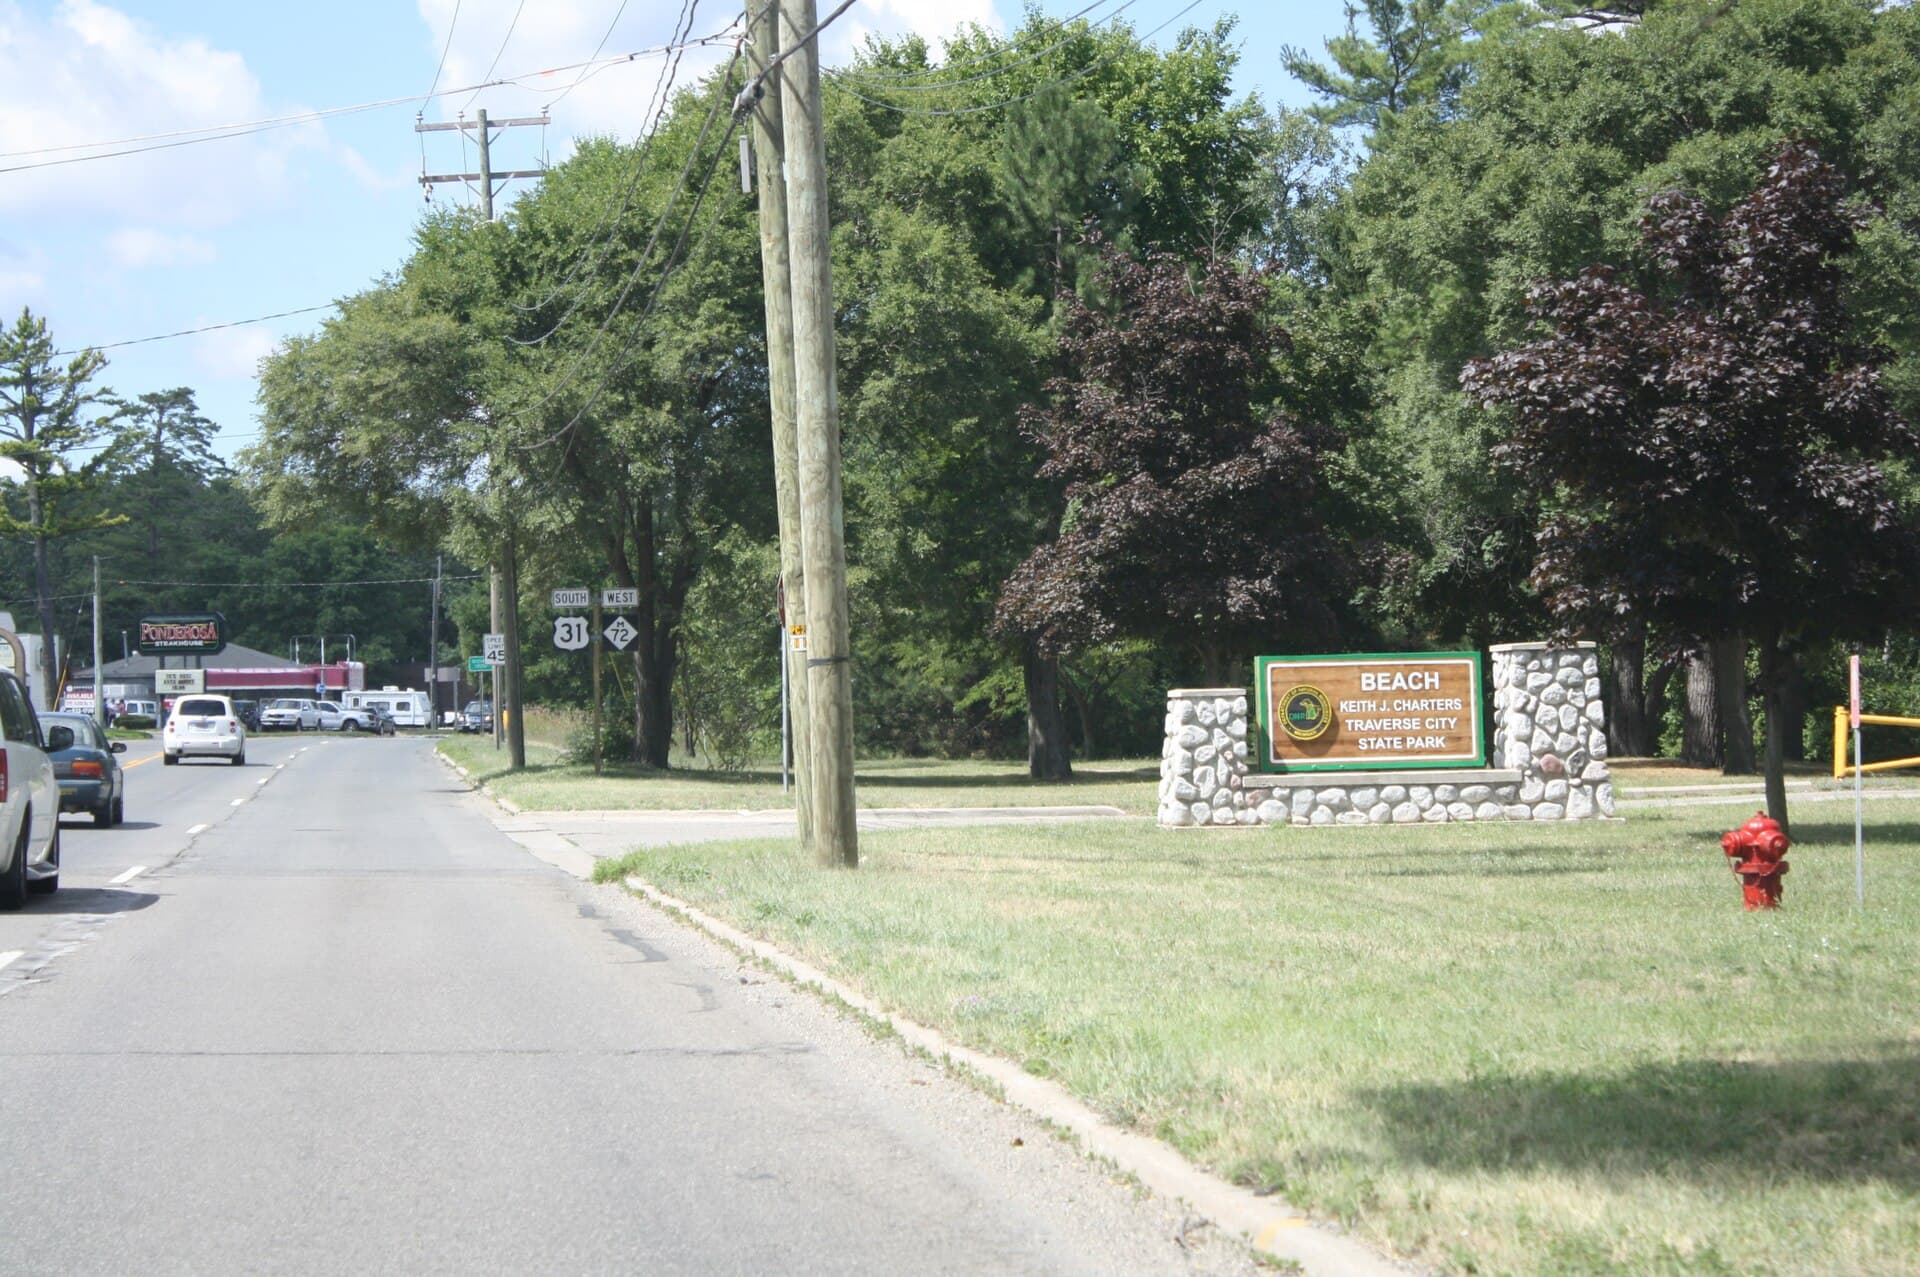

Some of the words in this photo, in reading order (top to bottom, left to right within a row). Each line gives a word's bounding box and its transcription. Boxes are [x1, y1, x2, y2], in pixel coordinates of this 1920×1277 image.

[555, 592, 587, 604] SOUTH
[607, 592, 633, 603] WEST
[141, 622, 217, 641] PONDEROSA
[560, 623, 581, 643] 31
[610, 628, 629, 642] 72
[487, 650, 505, 662] 45
[1360, 671, 1440, 691] BEACH
[1339, 699, 1376, 713] KEITH
[1379, 700, 1390, 712] J.
[1393, 698, 1463, 712] CHARTERS
[1345, 718, 1421, 731] TRAVERSE
[1425, 717, 1458, 730] CITY
[1358, 737, 1403, 750] STATE
[1406, 736, 1446, 749] PARK
